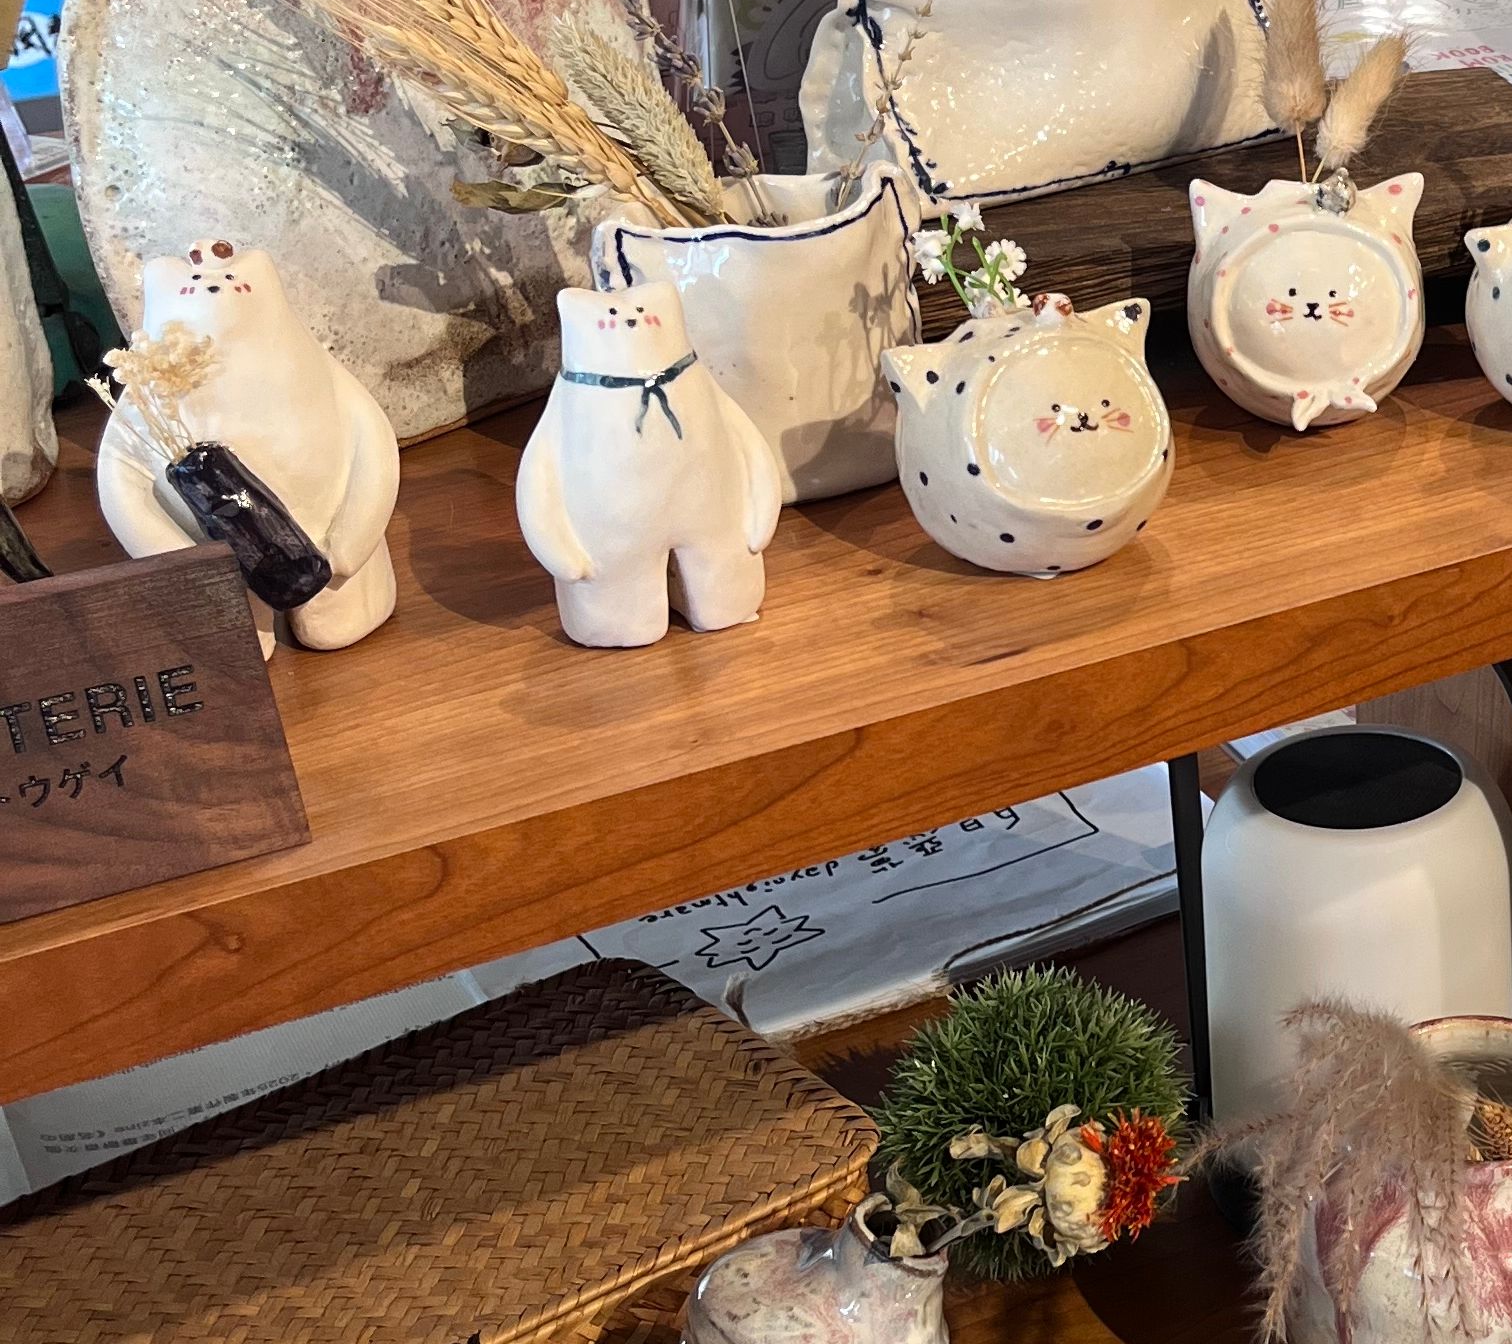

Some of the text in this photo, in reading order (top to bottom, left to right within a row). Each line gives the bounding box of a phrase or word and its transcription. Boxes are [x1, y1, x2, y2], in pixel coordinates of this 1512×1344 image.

[1431, 44, 1495, 61] BOOK
[0, 664, 204, 753] TERIE
[0, 755, 128, 808] ウゲイ
